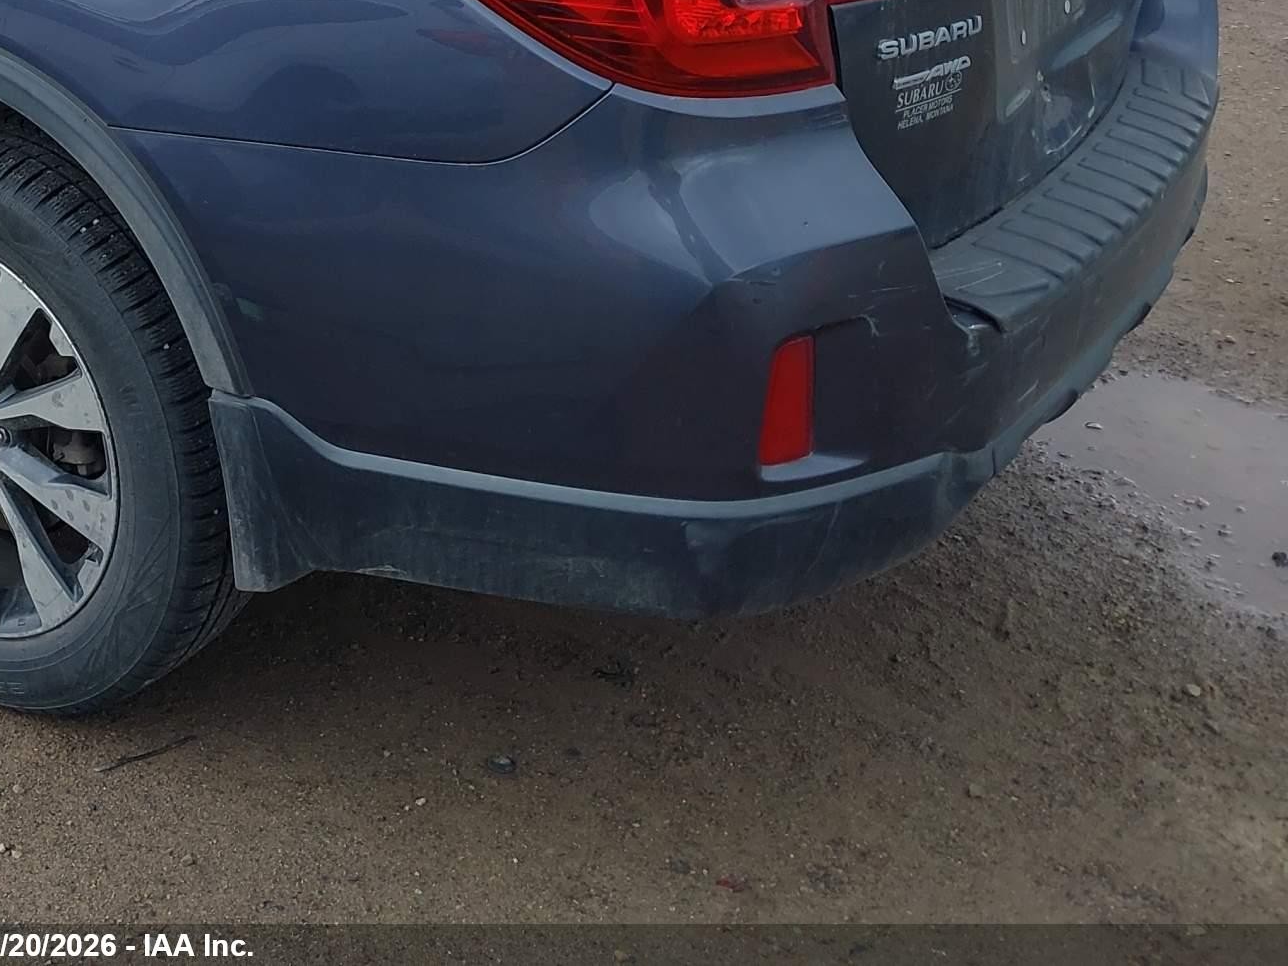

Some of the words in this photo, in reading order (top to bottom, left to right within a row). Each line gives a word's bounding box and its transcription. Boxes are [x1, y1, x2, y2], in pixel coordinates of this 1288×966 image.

[878, 15, 983, 60] SUBARU
[897, 80, 946, 109] SUBARU
[903, 104, 929, 118] PLACER
[928, 96, 954, 111] MOTORS
[925, 105, 954, 122] MONTANA
